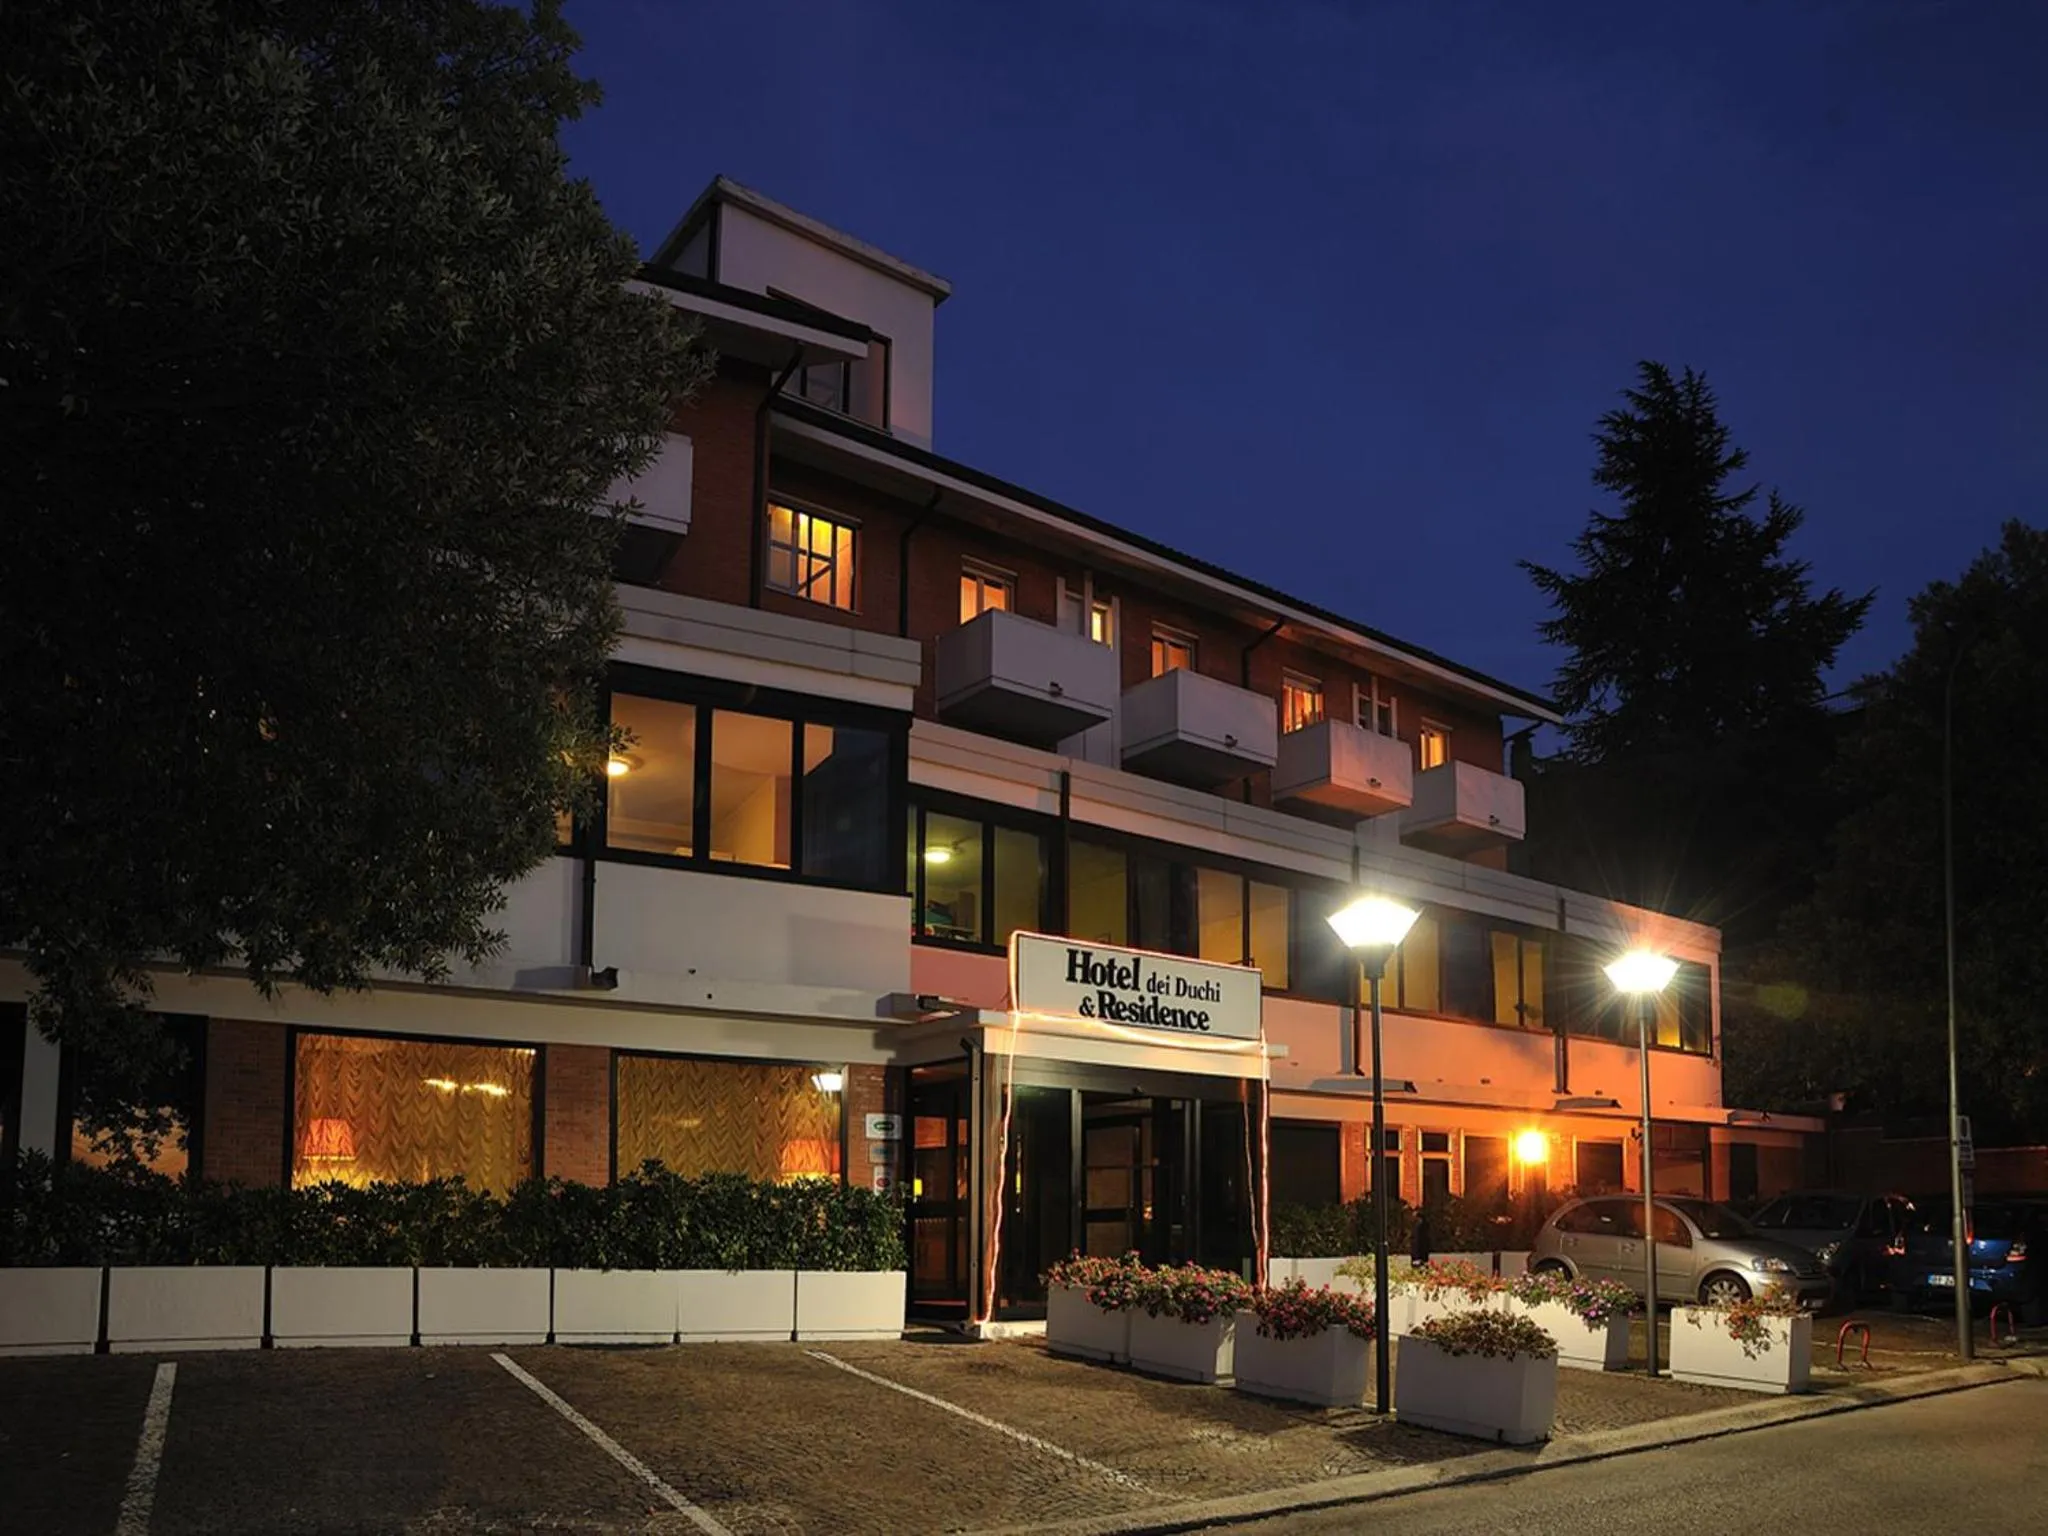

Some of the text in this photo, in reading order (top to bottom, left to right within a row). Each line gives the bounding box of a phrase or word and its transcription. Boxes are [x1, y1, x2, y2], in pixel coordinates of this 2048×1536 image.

[1066, 949, 1221, 1003] Hotel dei Duchi
[1079, 990, 1210, 1031] & Residence
